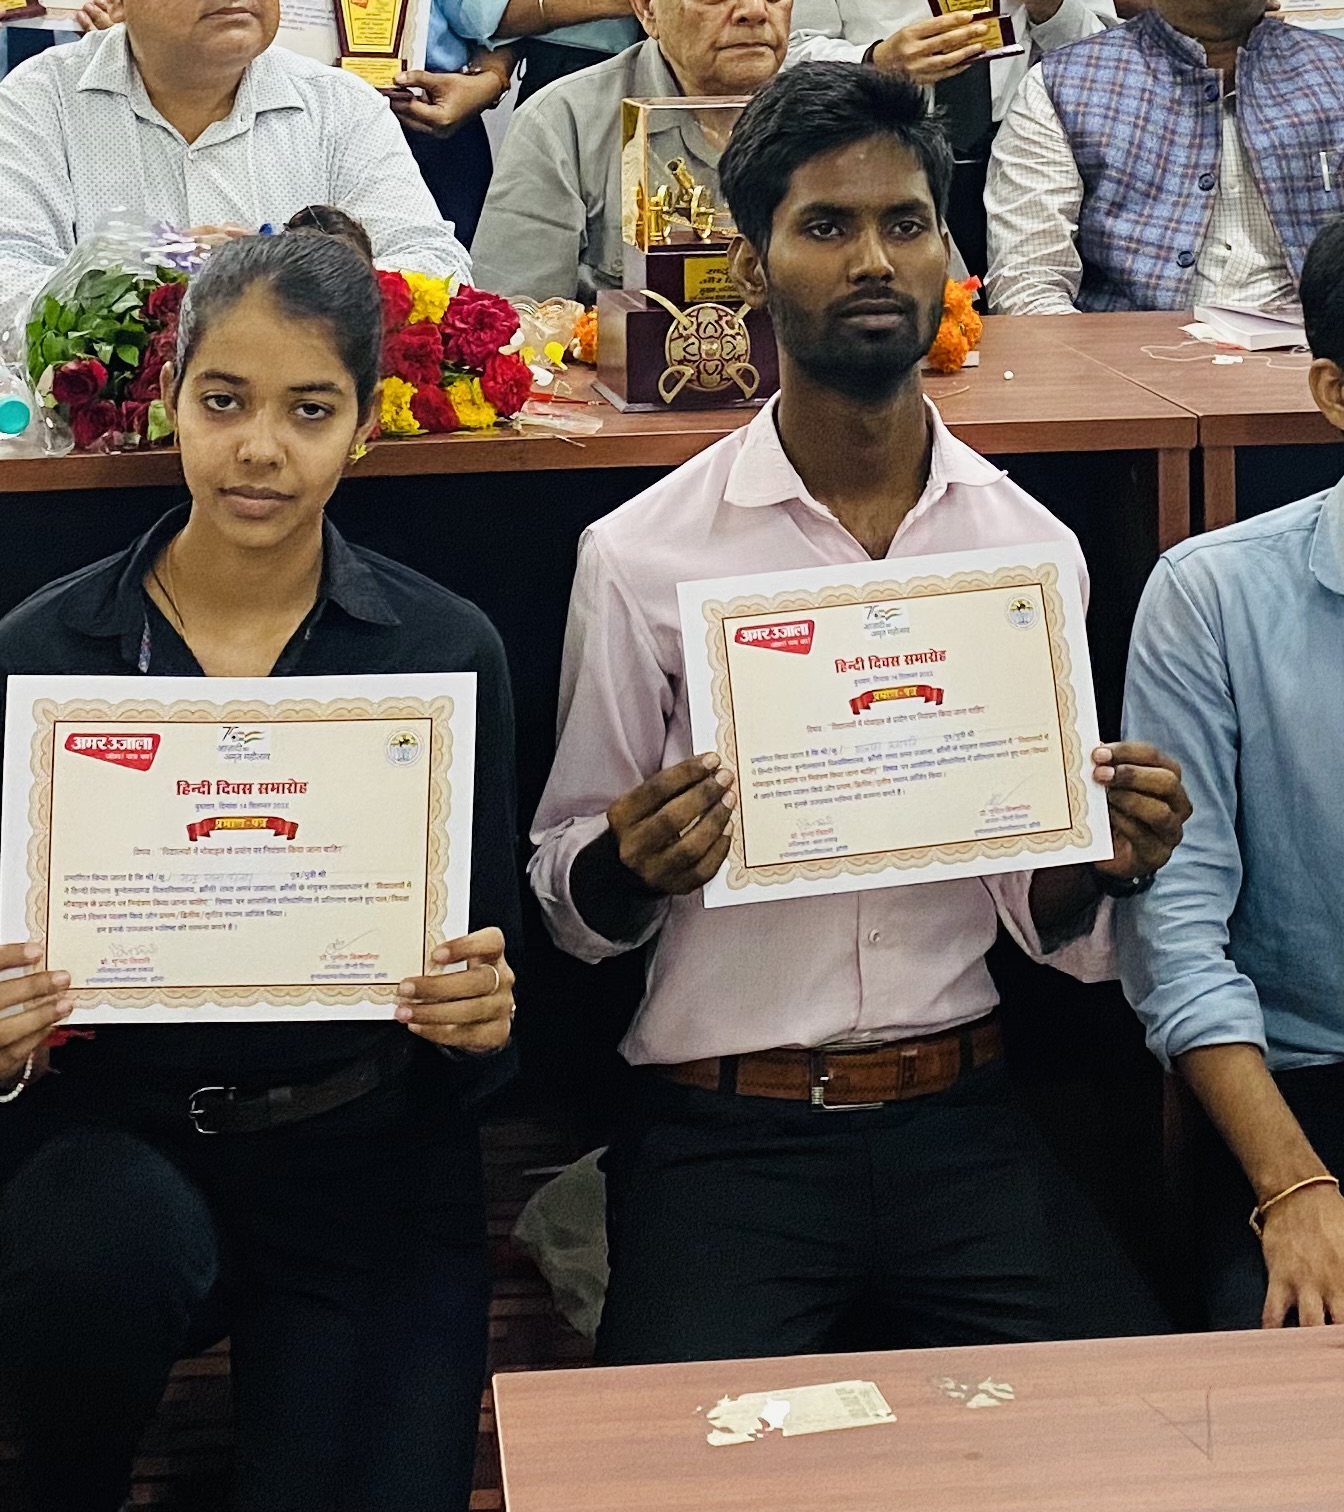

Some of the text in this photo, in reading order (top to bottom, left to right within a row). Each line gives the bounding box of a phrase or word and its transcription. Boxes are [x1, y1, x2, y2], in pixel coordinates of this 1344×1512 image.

[739, 627, 770, 642] अमर
[769, 622, 808, 638] उजाला
[834, 646, 947, 672] हिन्दी दिवस समारोह
[71, 736, 152, 750] अमर उजाला
[176, 778, 308, 795] हिन्दी दिवस समारोह
